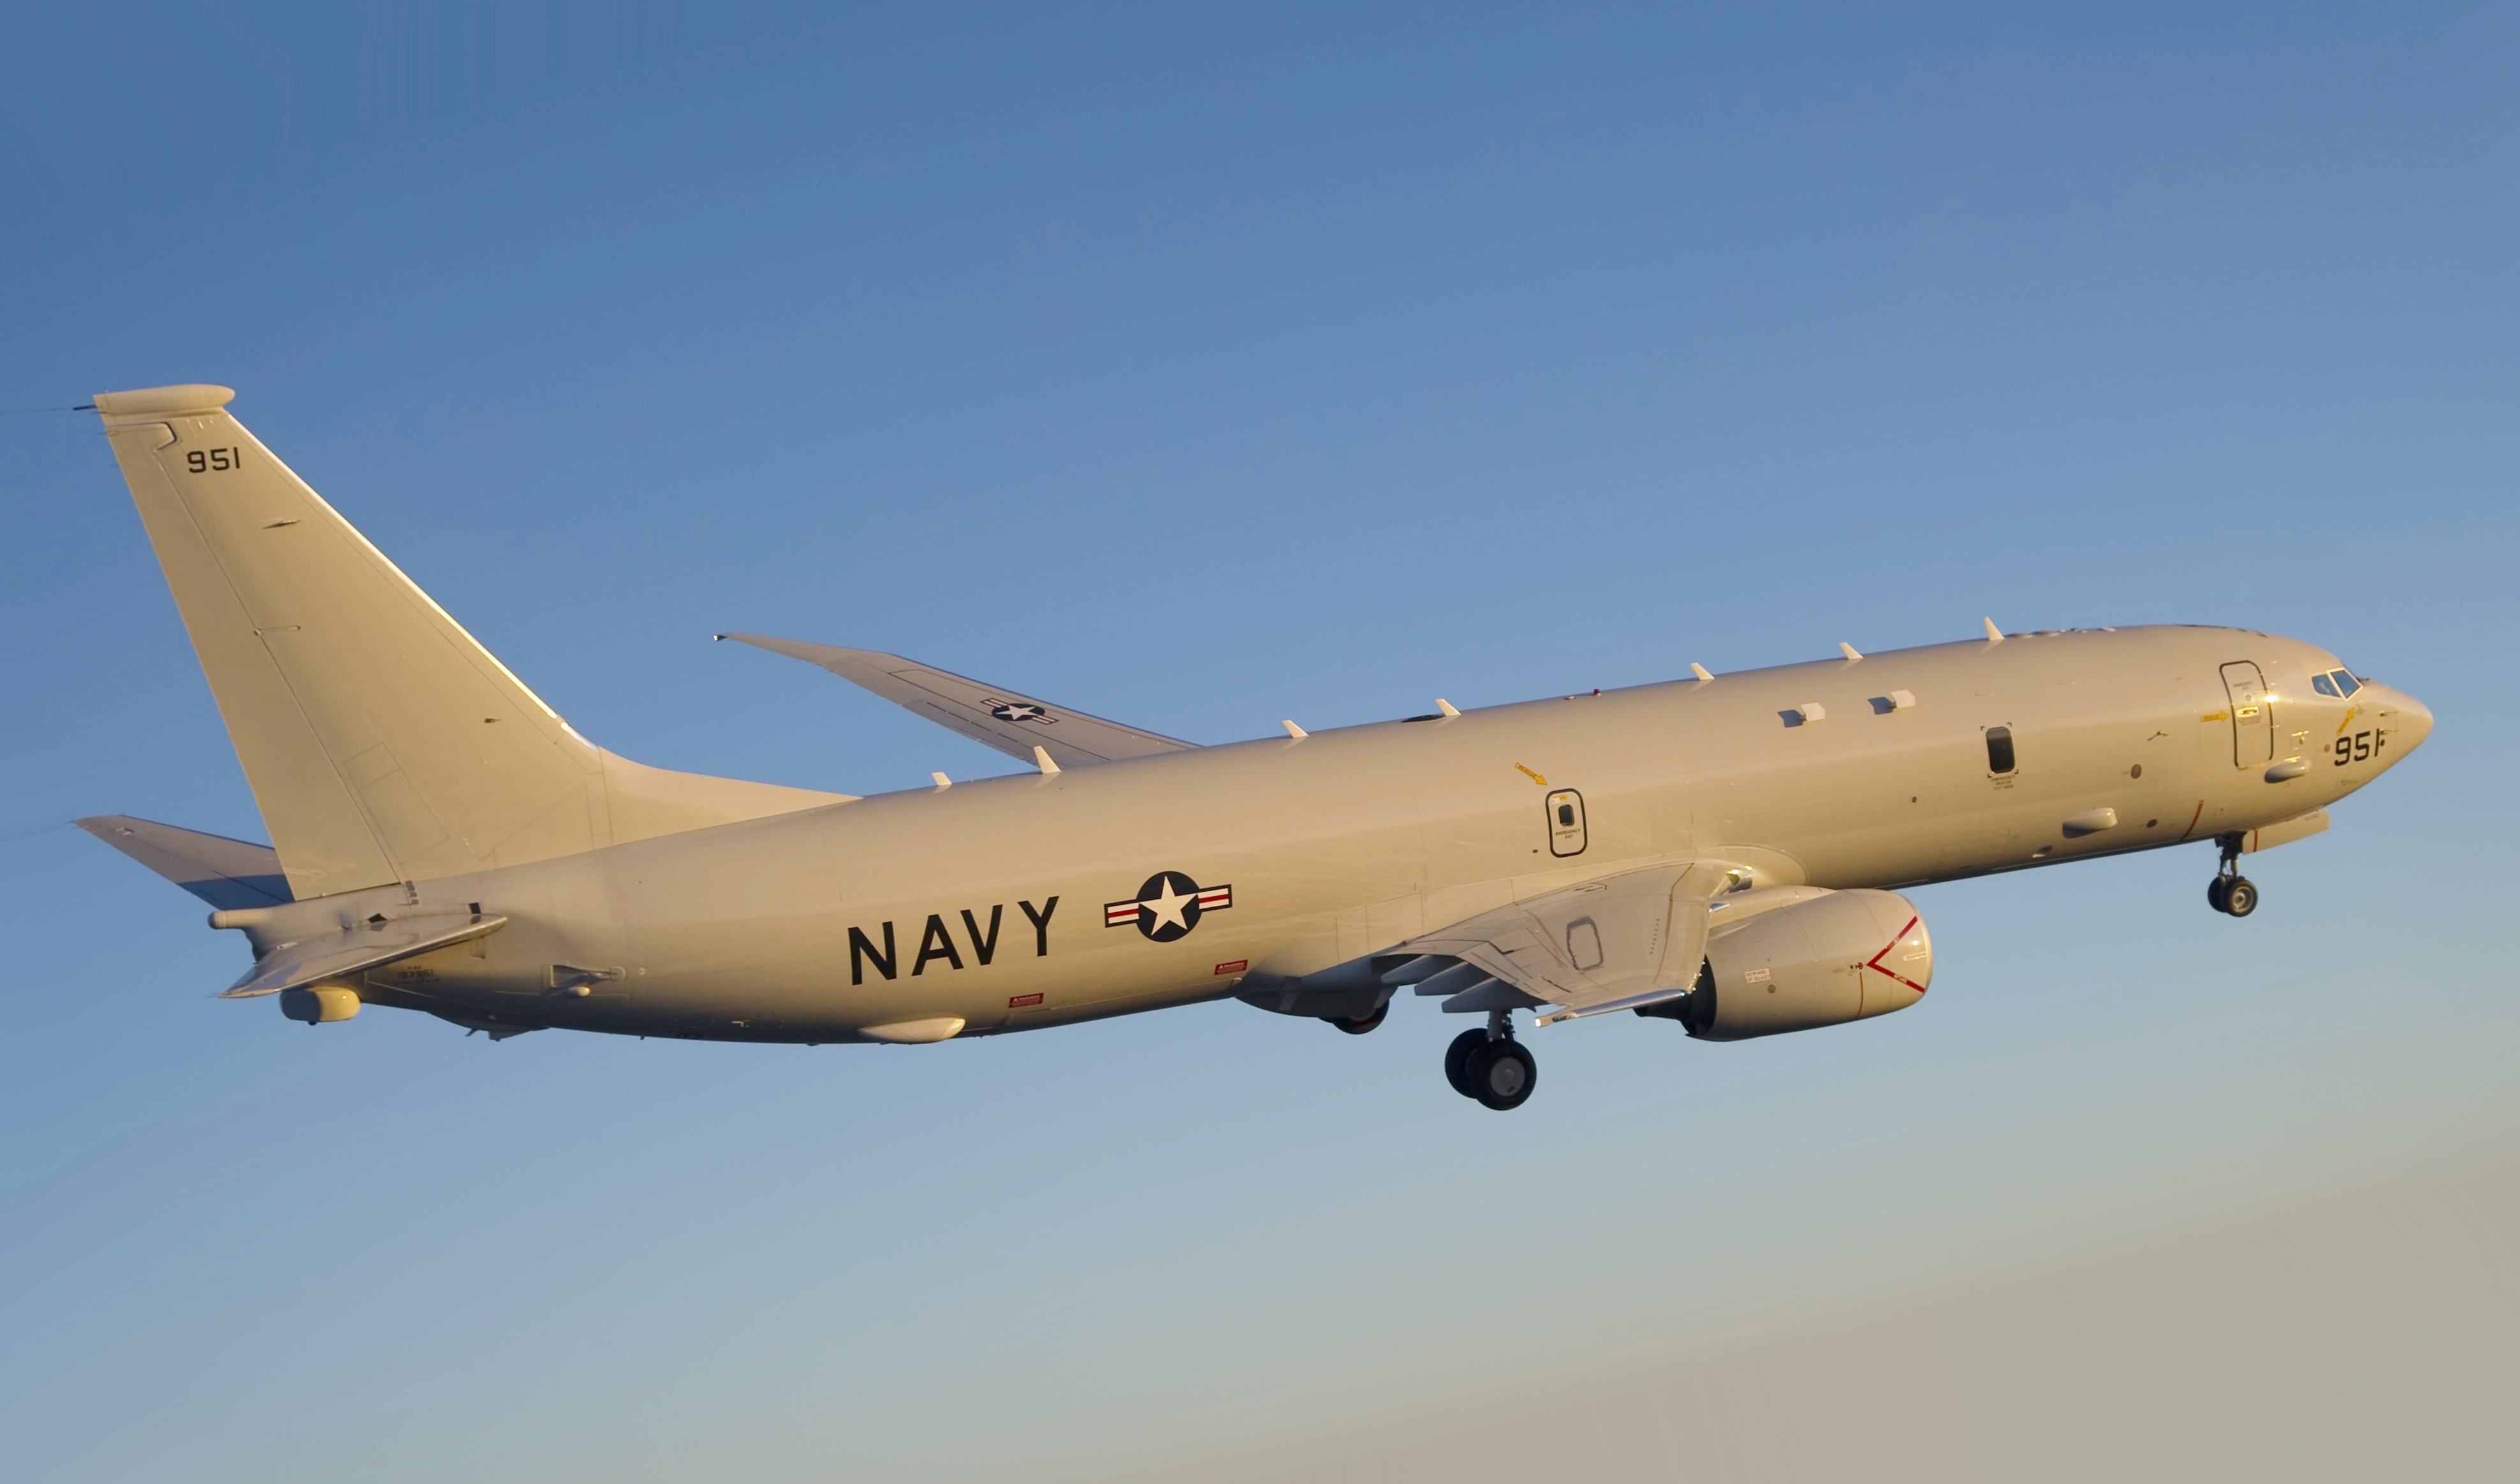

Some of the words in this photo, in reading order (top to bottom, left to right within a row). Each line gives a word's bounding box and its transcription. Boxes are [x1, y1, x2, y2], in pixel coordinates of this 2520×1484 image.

[187, 446, 240, 473] 951
[2334, 728, 2380, 766] 951
[847, 896, 1059, 986] NAVY
